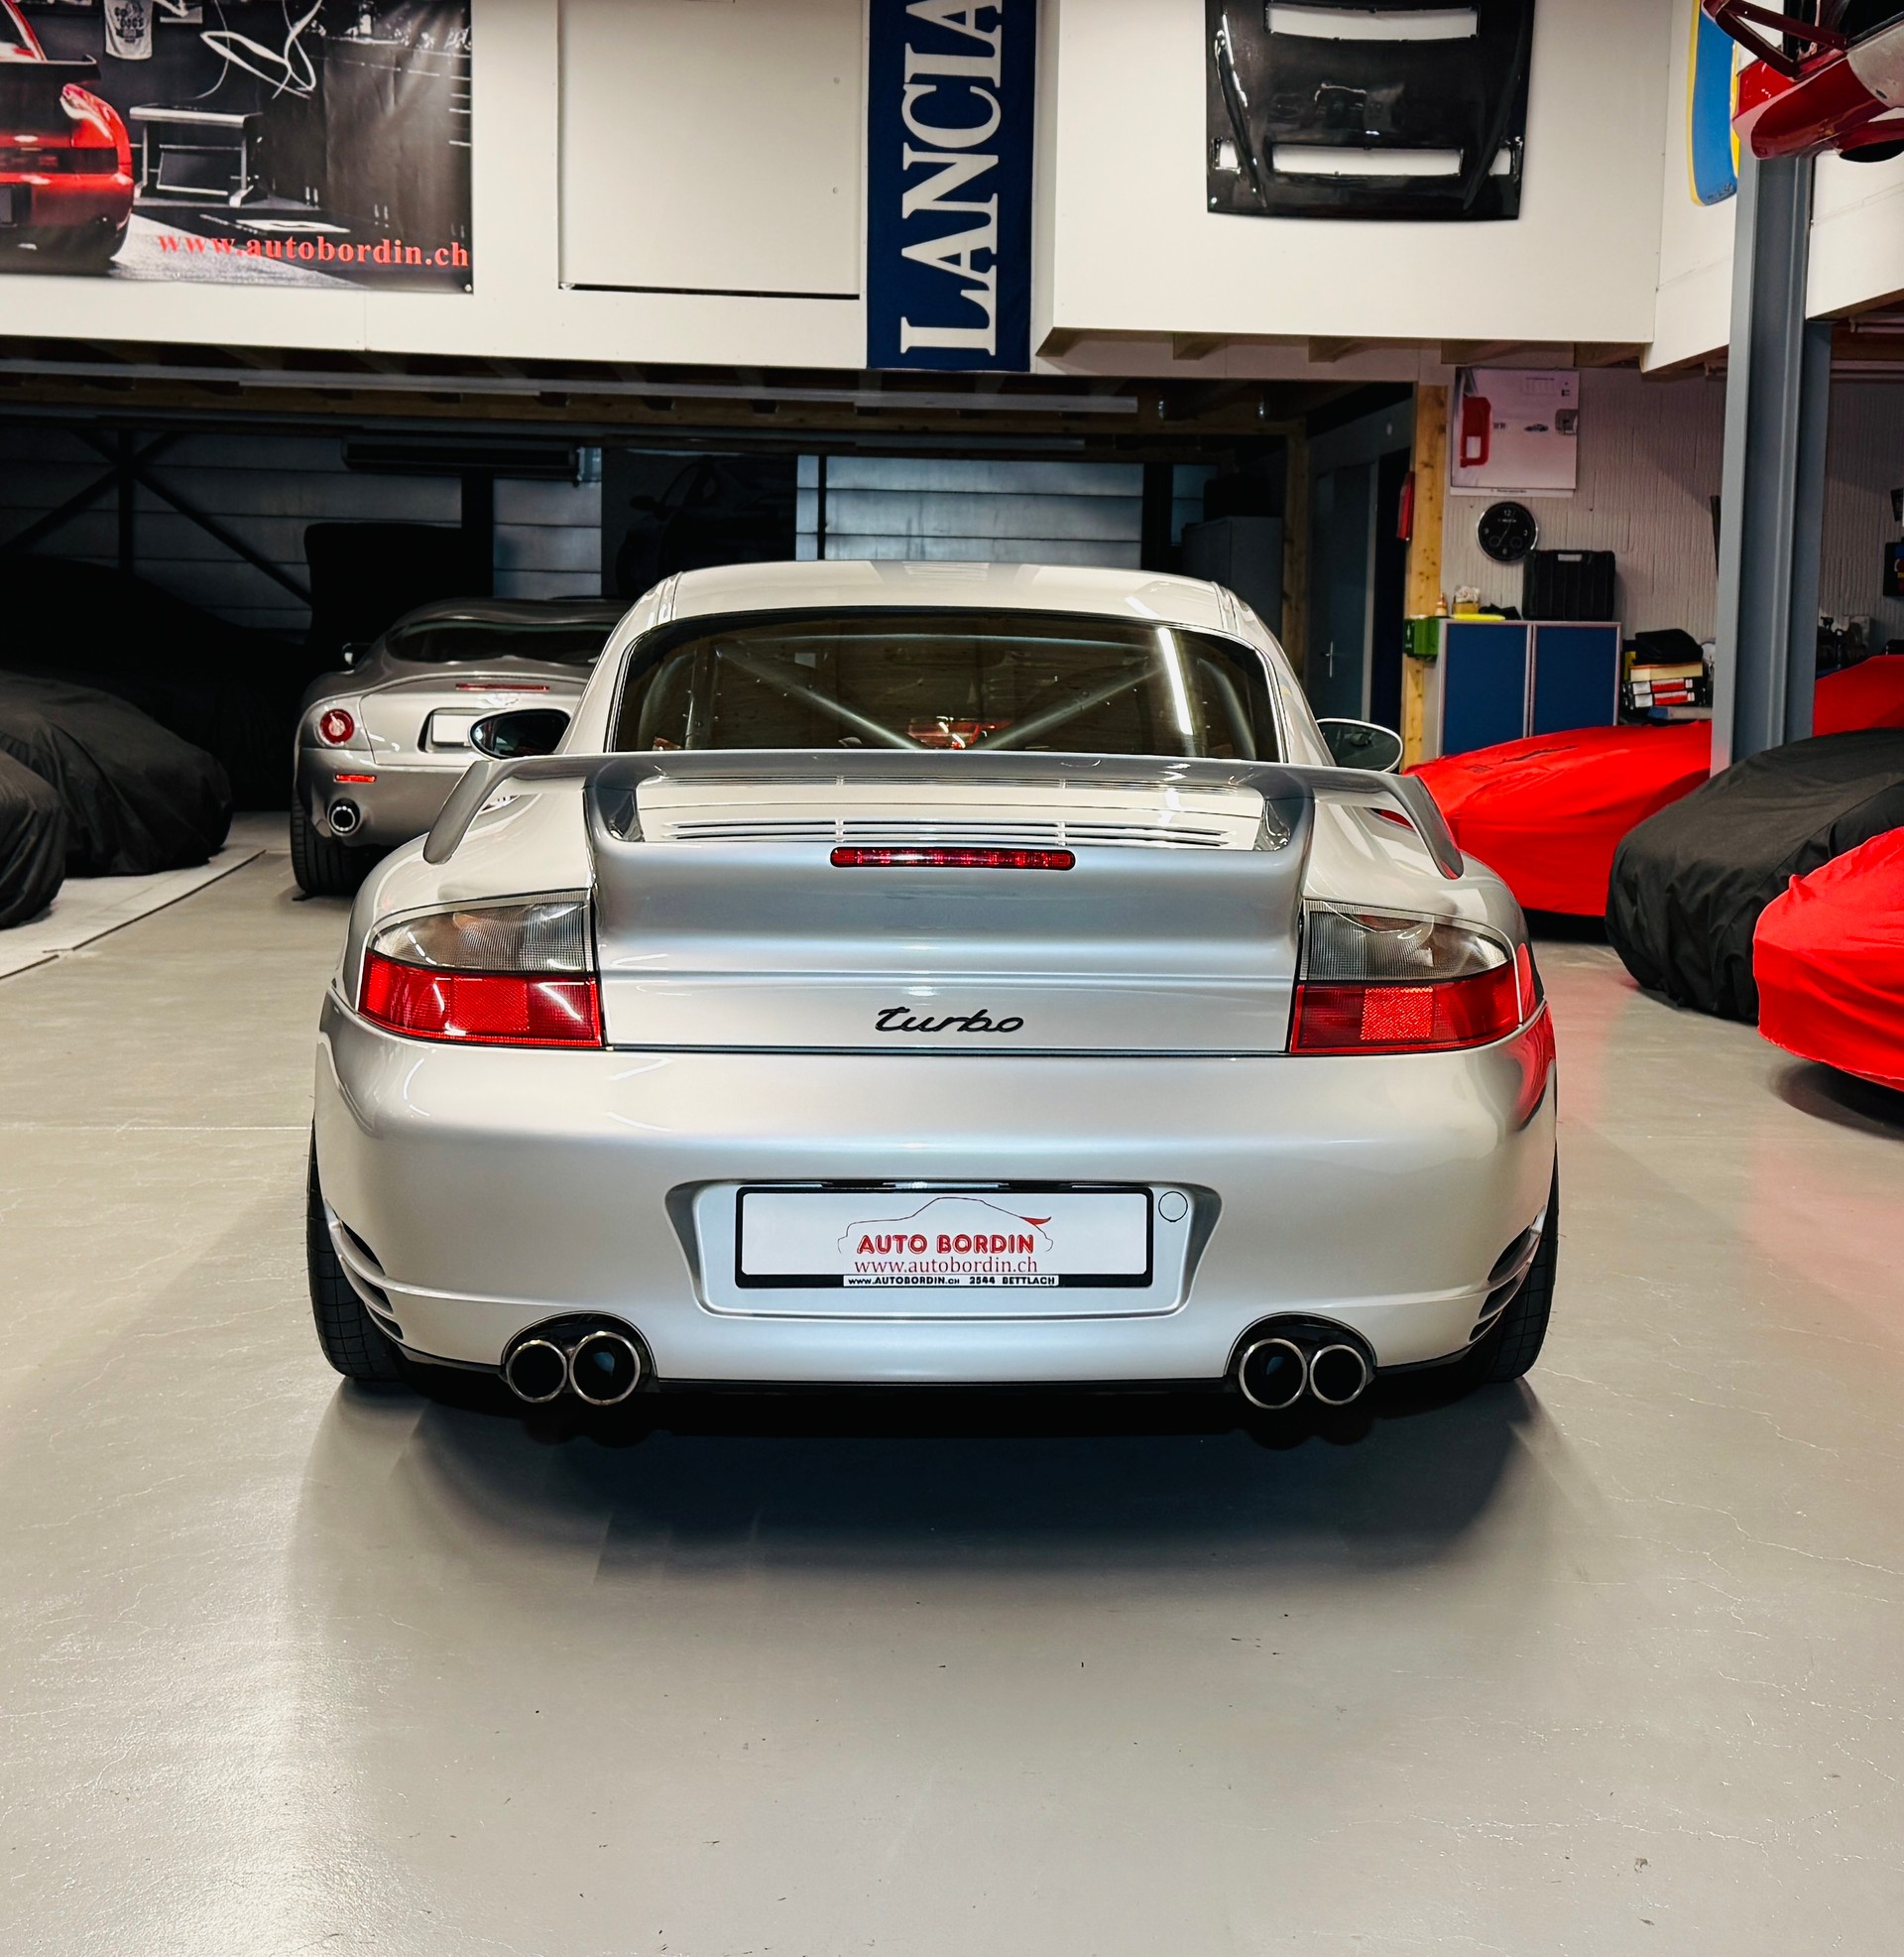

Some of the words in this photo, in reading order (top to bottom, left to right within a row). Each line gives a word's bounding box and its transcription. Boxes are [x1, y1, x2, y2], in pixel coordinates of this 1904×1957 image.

[159, 231, 470, 268] www.autobordin.ch
[875, 1006, 1023, 1033] turbo
[857, 1234, 927, 1255] AUTO
[937, 1234, 1034, 1255] BORDIN
[855, 1256, 1037, 1274] www.autobordin.ch
[969, 1276, 996, 1285] 2544
[1002, 1276, 1055, 1285] BETTLACH
